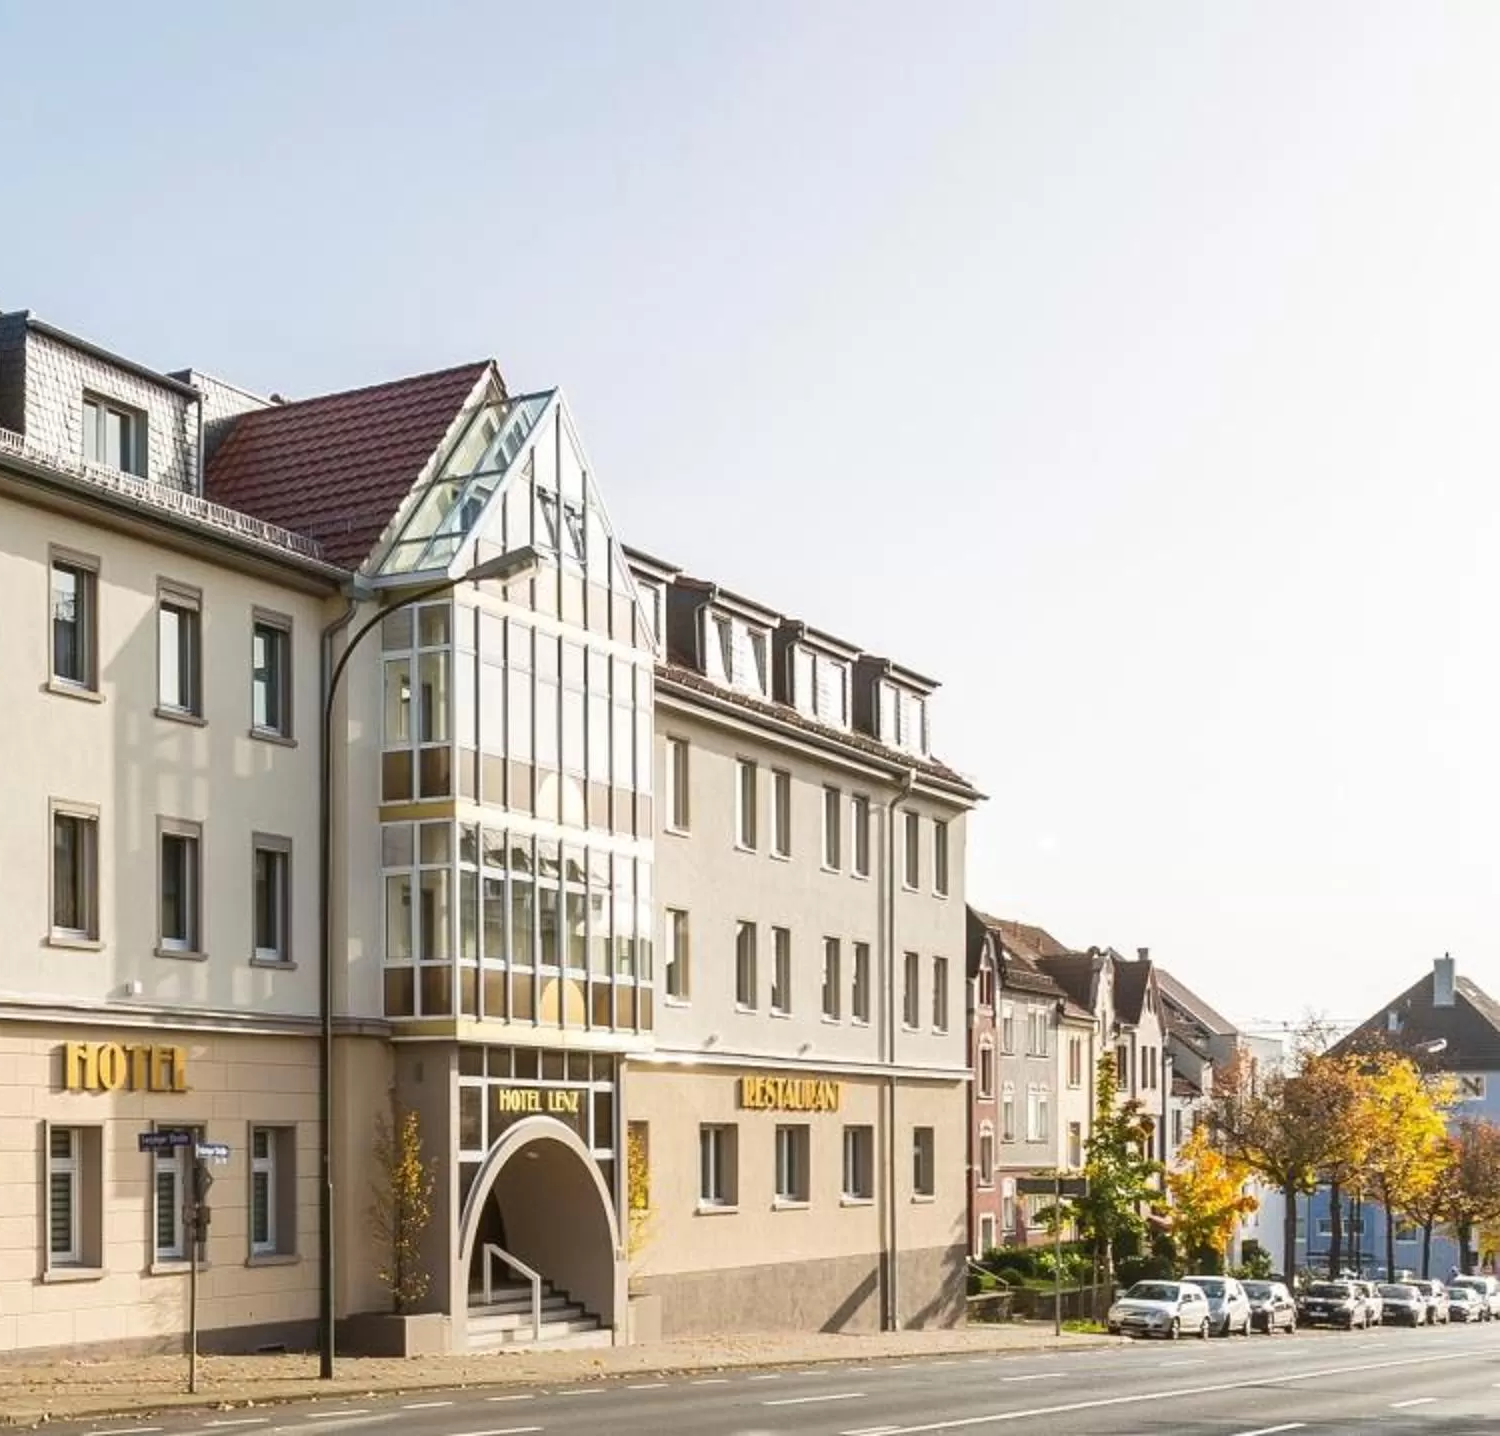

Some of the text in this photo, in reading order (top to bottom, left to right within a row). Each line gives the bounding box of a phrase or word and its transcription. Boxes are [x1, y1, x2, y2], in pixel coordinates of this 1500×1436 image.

[66, 1042, 189, 1091] HOTEL
[499, 1089, 579, 1112] HOTEL LENZ
